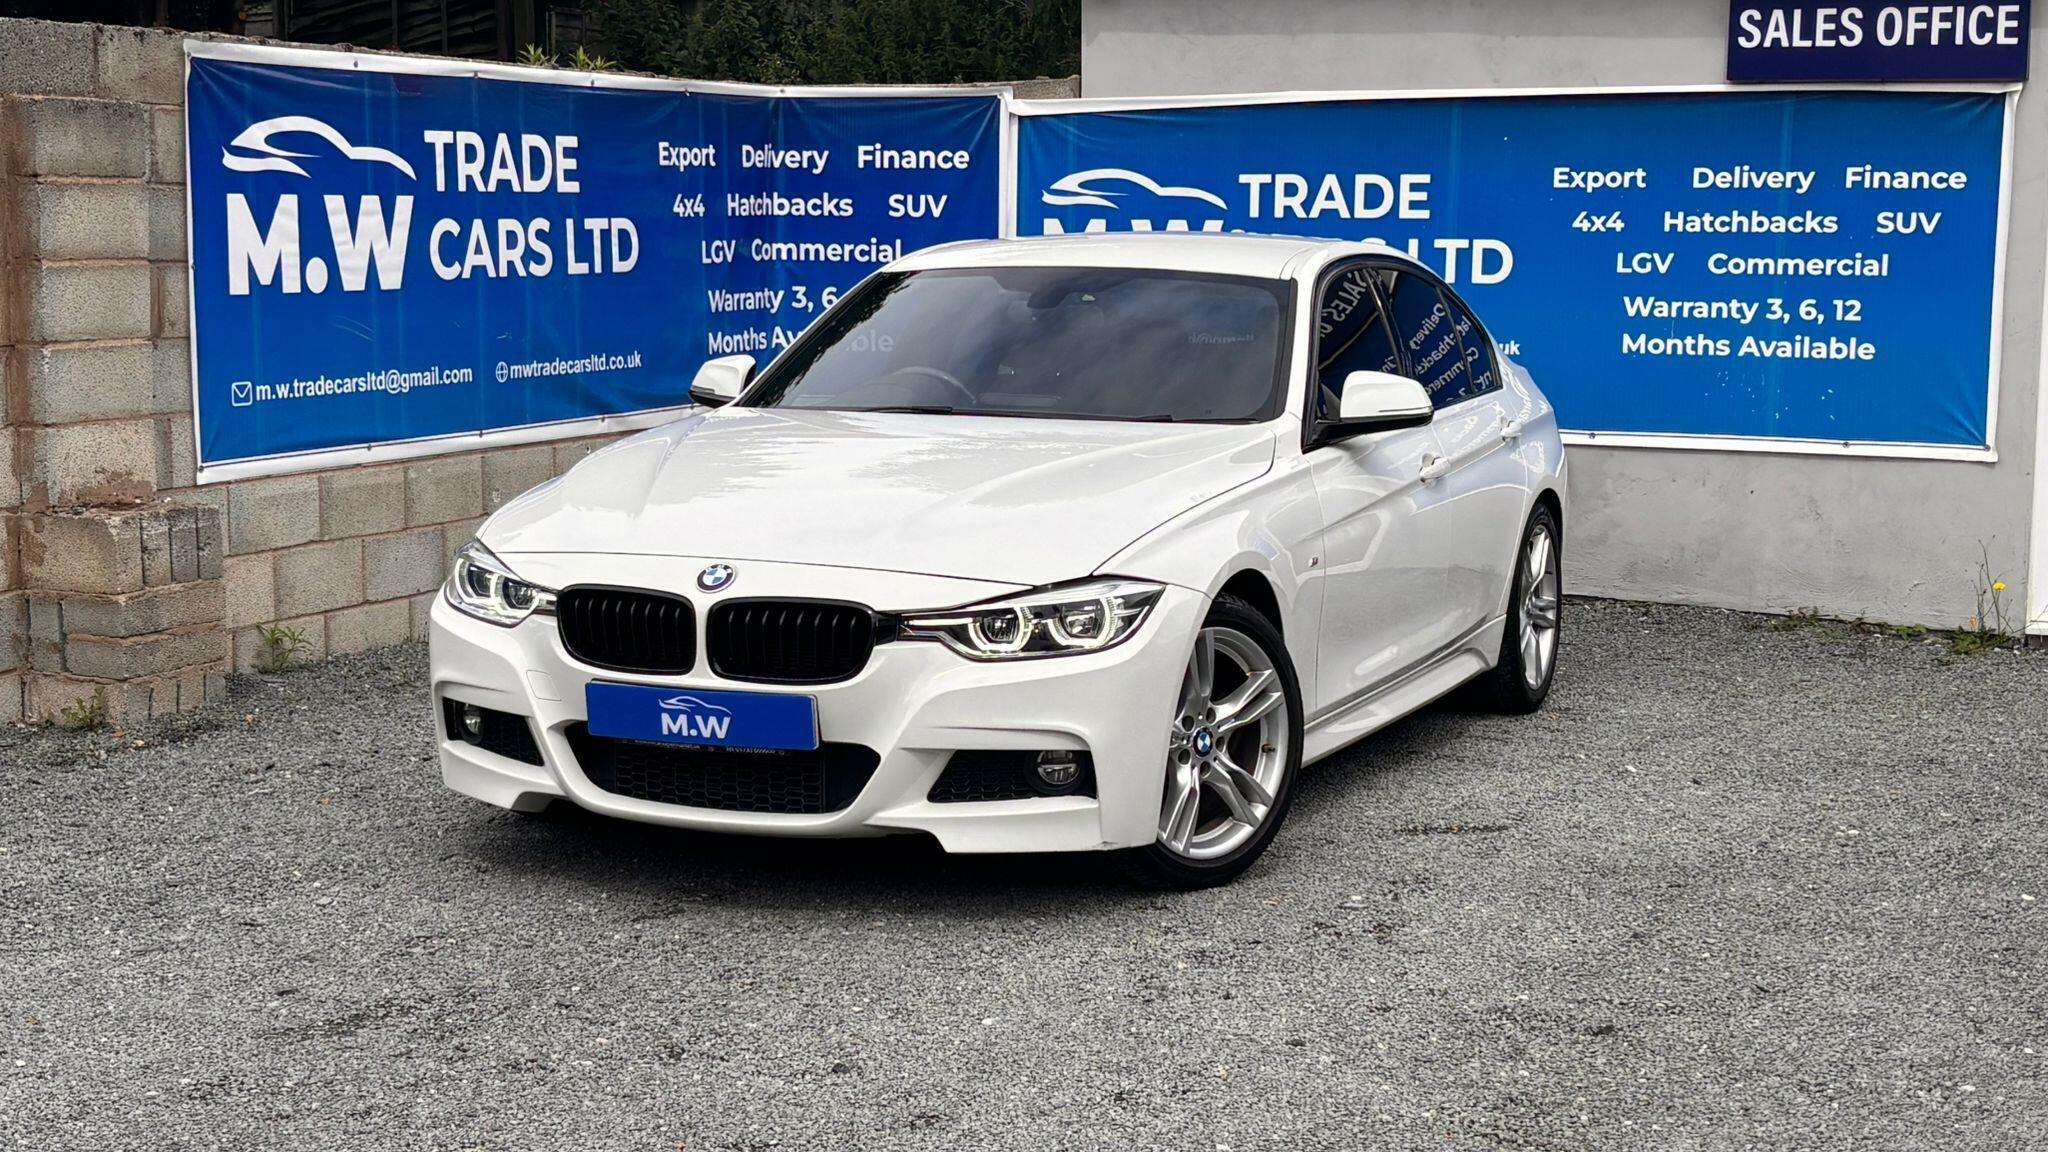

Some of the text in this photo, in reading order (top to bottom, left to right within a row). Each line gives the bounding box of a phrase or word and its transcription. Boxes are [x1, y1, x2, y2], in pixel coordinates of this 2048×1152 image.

[1738, 5, 2019, 48] SALES OFFICE
[424, 130, 580, 193] TRADE
[658, 141, 970, 174] Export Delivery Finance
[1554, 165, 1968, 193] Export Delivery Finance
[673, 192, 948, 218] 4x4 Hatchbacks SUV
[1239, 174, 1431, 219] TRADE
[1572, 210, 1942, 234] 4x4 Hatchbacks SUV
[226, 193, 415, 296] M.W
[429, 217, 639, 280] CARS LTD
[702, 238, 901, 264] LGV Commercial
[1616, 252, 1889, 277] LGV Commercial
[708, 288, 784, 313] Warranty
[791, 286, 814, 313] 3,
[1624, 296, 1862, 325] Warranty 3, 6, 12
[708, 327, 768, 355] Months
[1622, 334, 1876, 361] Months Available
[510, 350, 642, 379] mwtradecarsltd.co.uk
[256, 366, 473, 401] m.w.tradecarsltd@gmail.com
[661, 712, 731, 739] M.W
